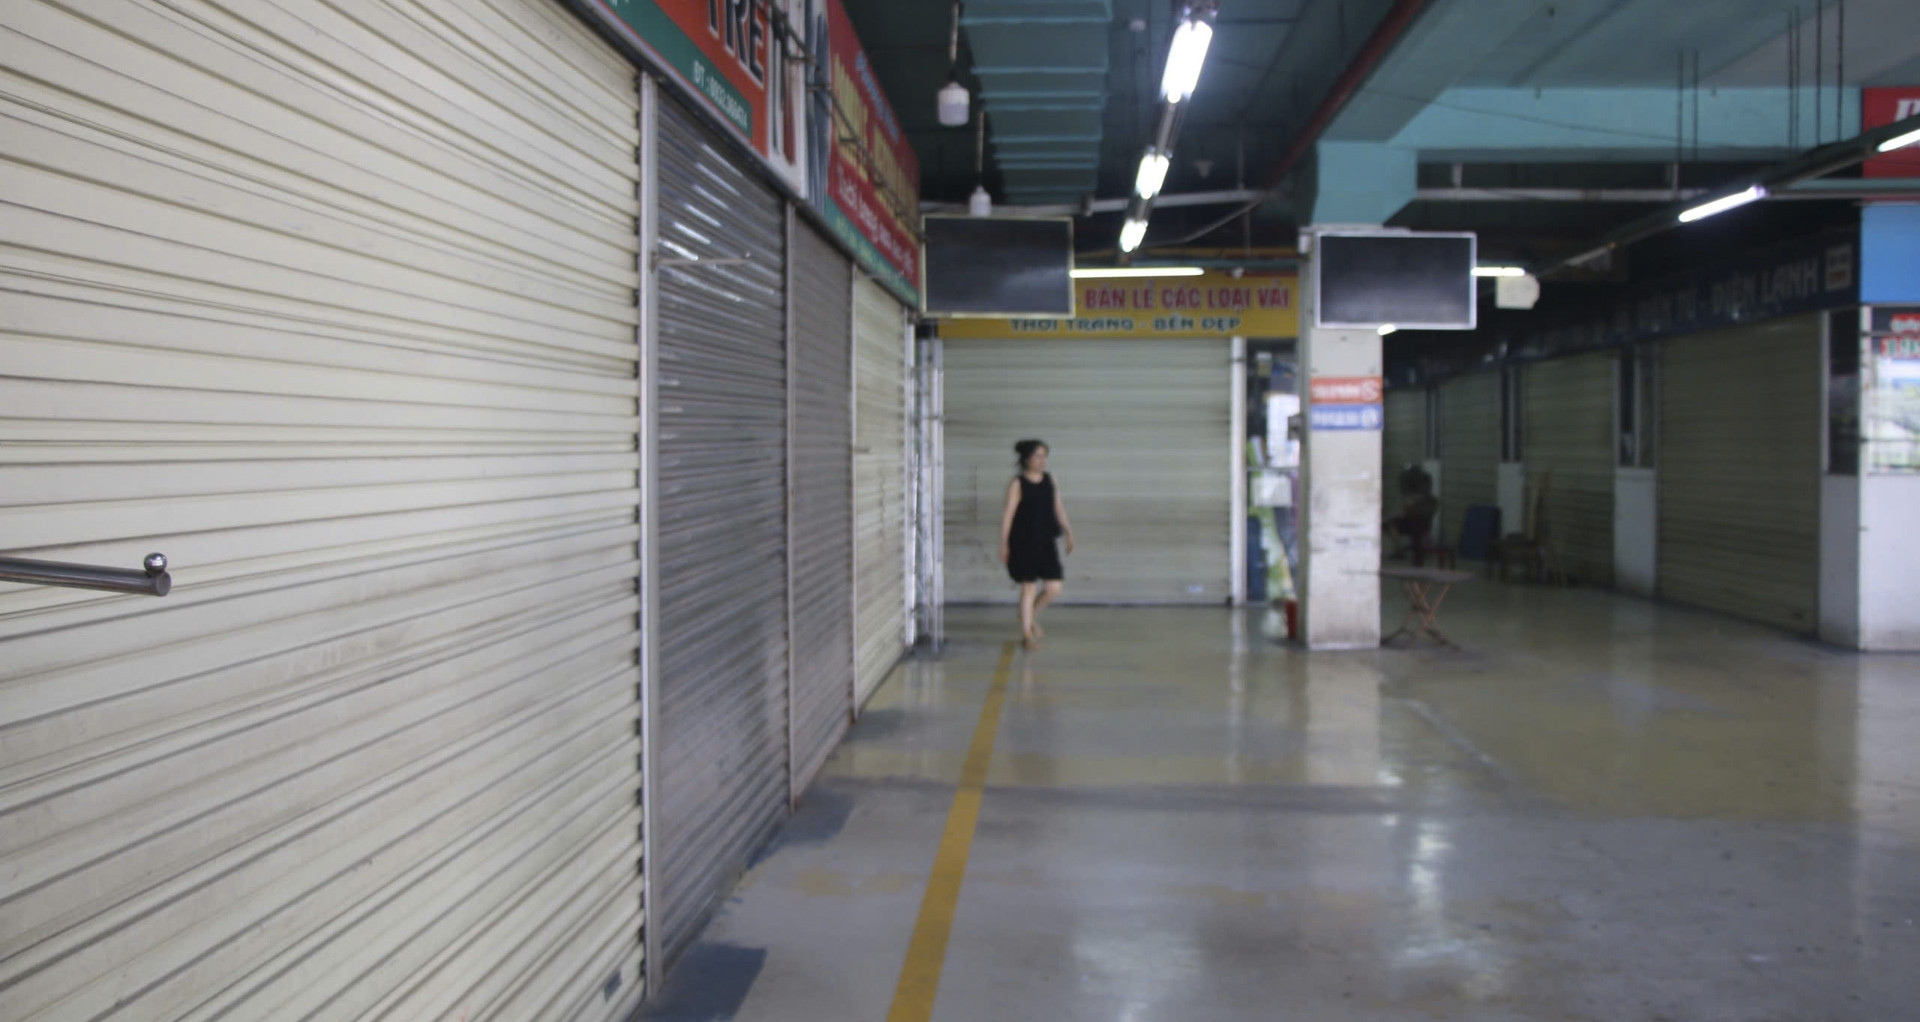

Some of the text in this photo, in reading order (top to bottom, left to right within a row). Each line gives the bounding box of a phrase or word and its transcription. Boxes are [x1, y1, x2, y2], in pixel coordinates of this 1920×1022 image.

[1084, 278, 1290, 313] BÁN LẺ CÁC LOẠI VẢI
[1760, 257, 1819, 313] LẠNH
[1064, 317, 1136, 332] TRANG
